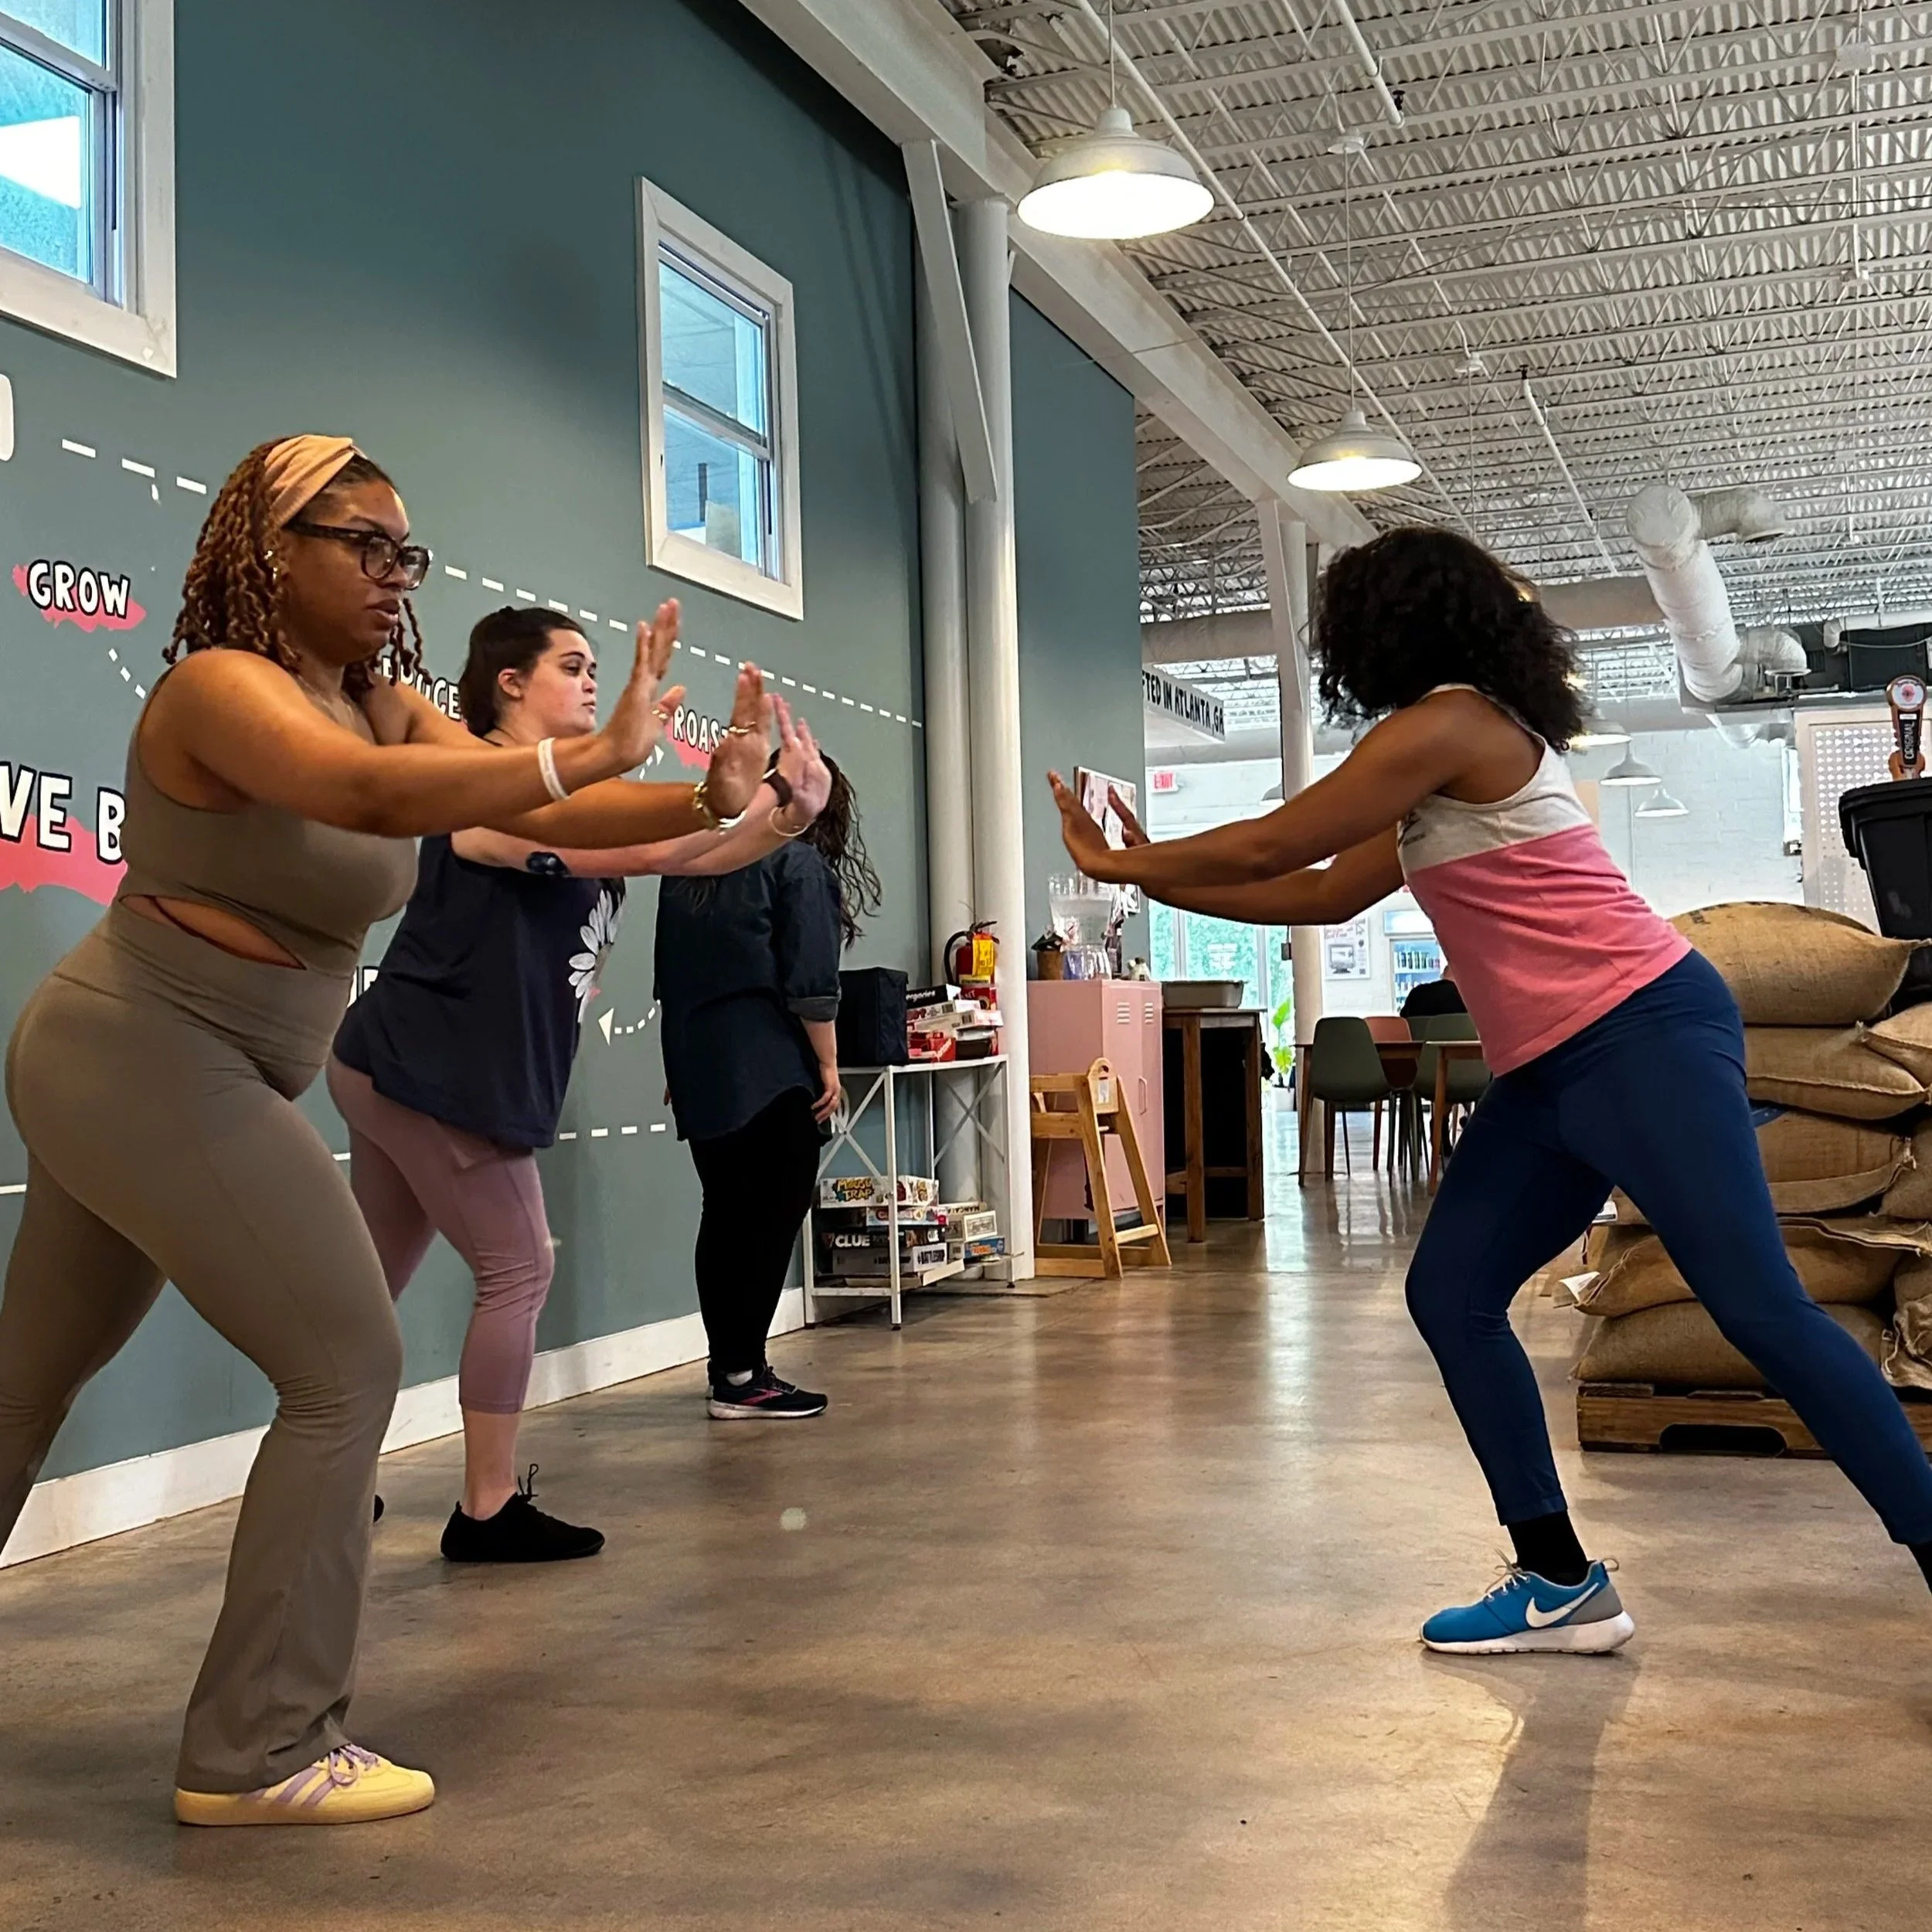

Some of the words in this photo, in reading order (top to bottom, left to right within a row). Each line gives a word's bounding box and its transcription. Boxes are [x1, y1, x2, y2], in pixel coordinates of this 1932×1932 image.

[27, 559, 131, 619] GROW
[1142, 670, 1161, 705] TED
[1163, 680, 1172, 711] IN
[1214, 706, 1225, 736] GA
[673, 704, 729, 754] ROAS
[1903, 720, 1915, 759] ORIGINAL
[1153, 773, 1174, 790] EXIT
[843, 1189, 872, 1200] TRAP
[835, 1234, 870, 1247] CLUE
